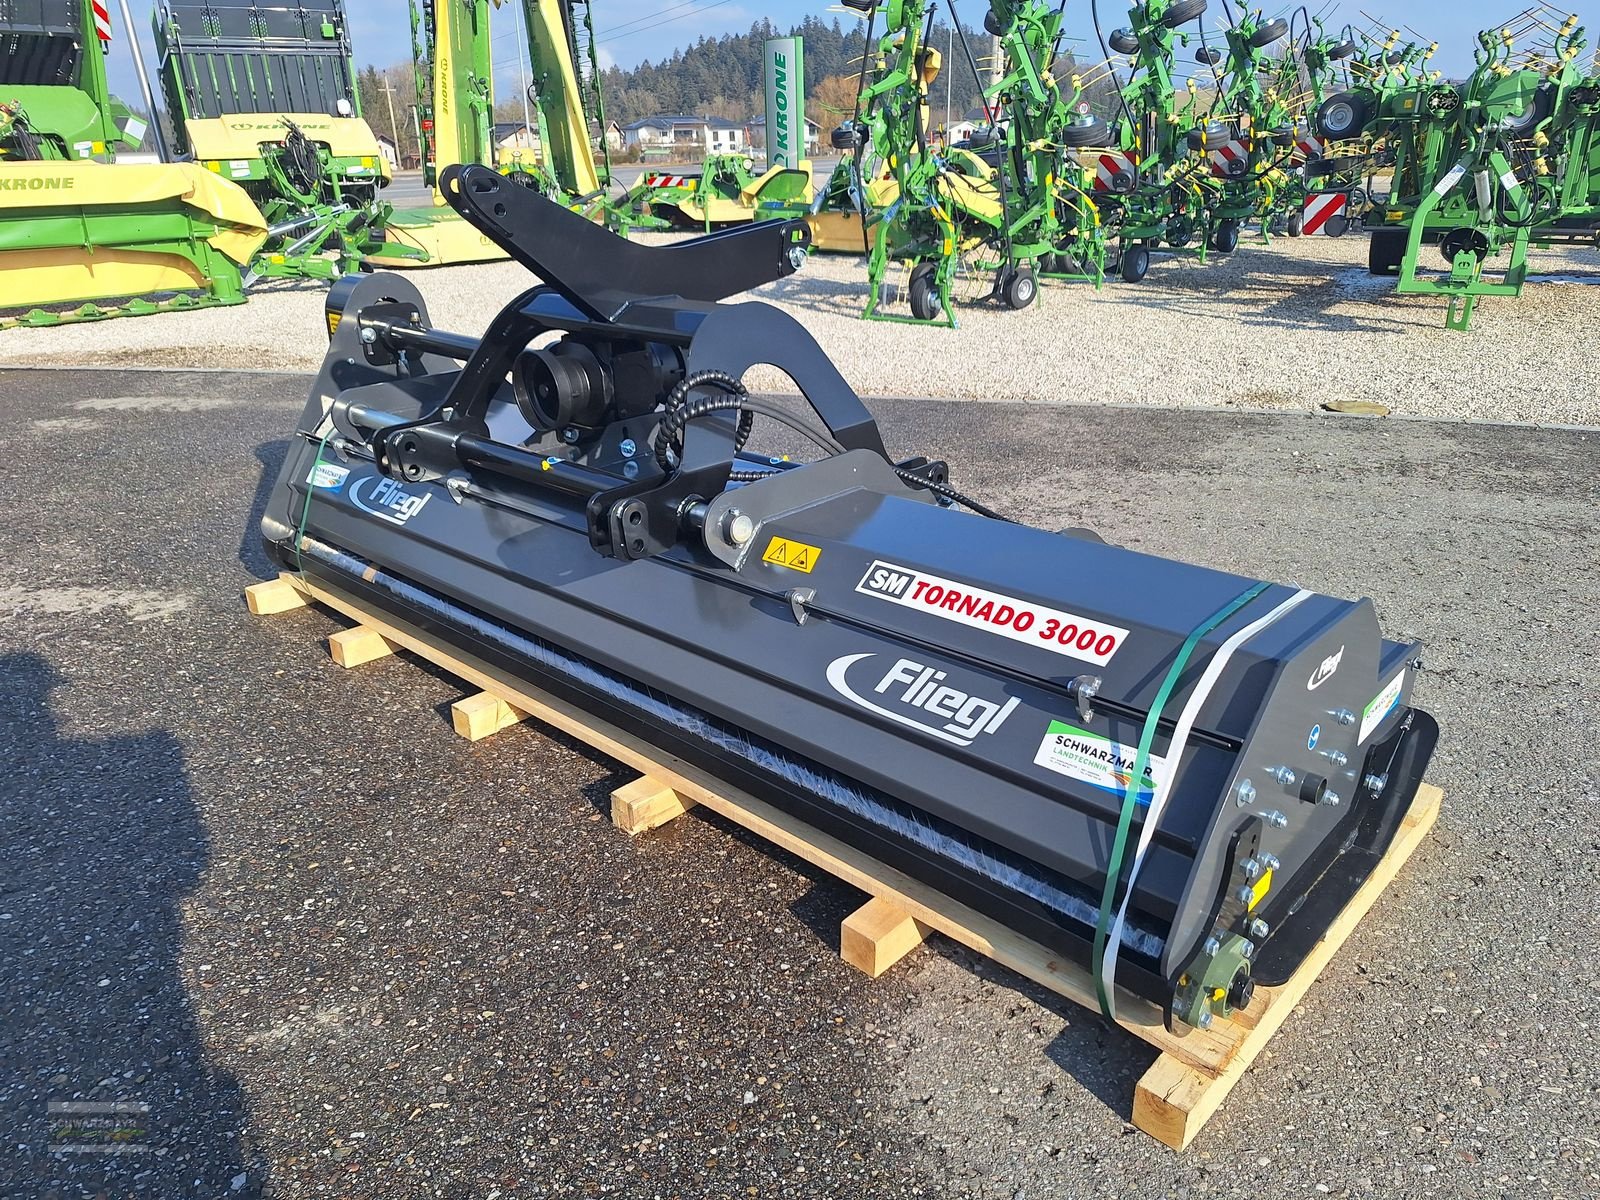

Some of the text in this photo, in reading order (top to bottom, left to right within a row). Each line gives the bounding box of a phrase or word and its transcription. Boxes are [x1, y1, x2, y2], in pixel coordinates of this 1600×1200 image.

[441, 73, 449, 115] KRONE
[774, 51, 788, 150] KRONE
[0, 177, 74, 190] KRONE
[369, 477, 432, 520] Fliegl
[869, 569, 1116, 656] SM TORNADO 3000
[874, 658, 1022, 739] Fliegl
[1053, 747, 1109, 772] LANDTECHNIK
[1055, 735, 1153, 777] SCHWARZMAR
